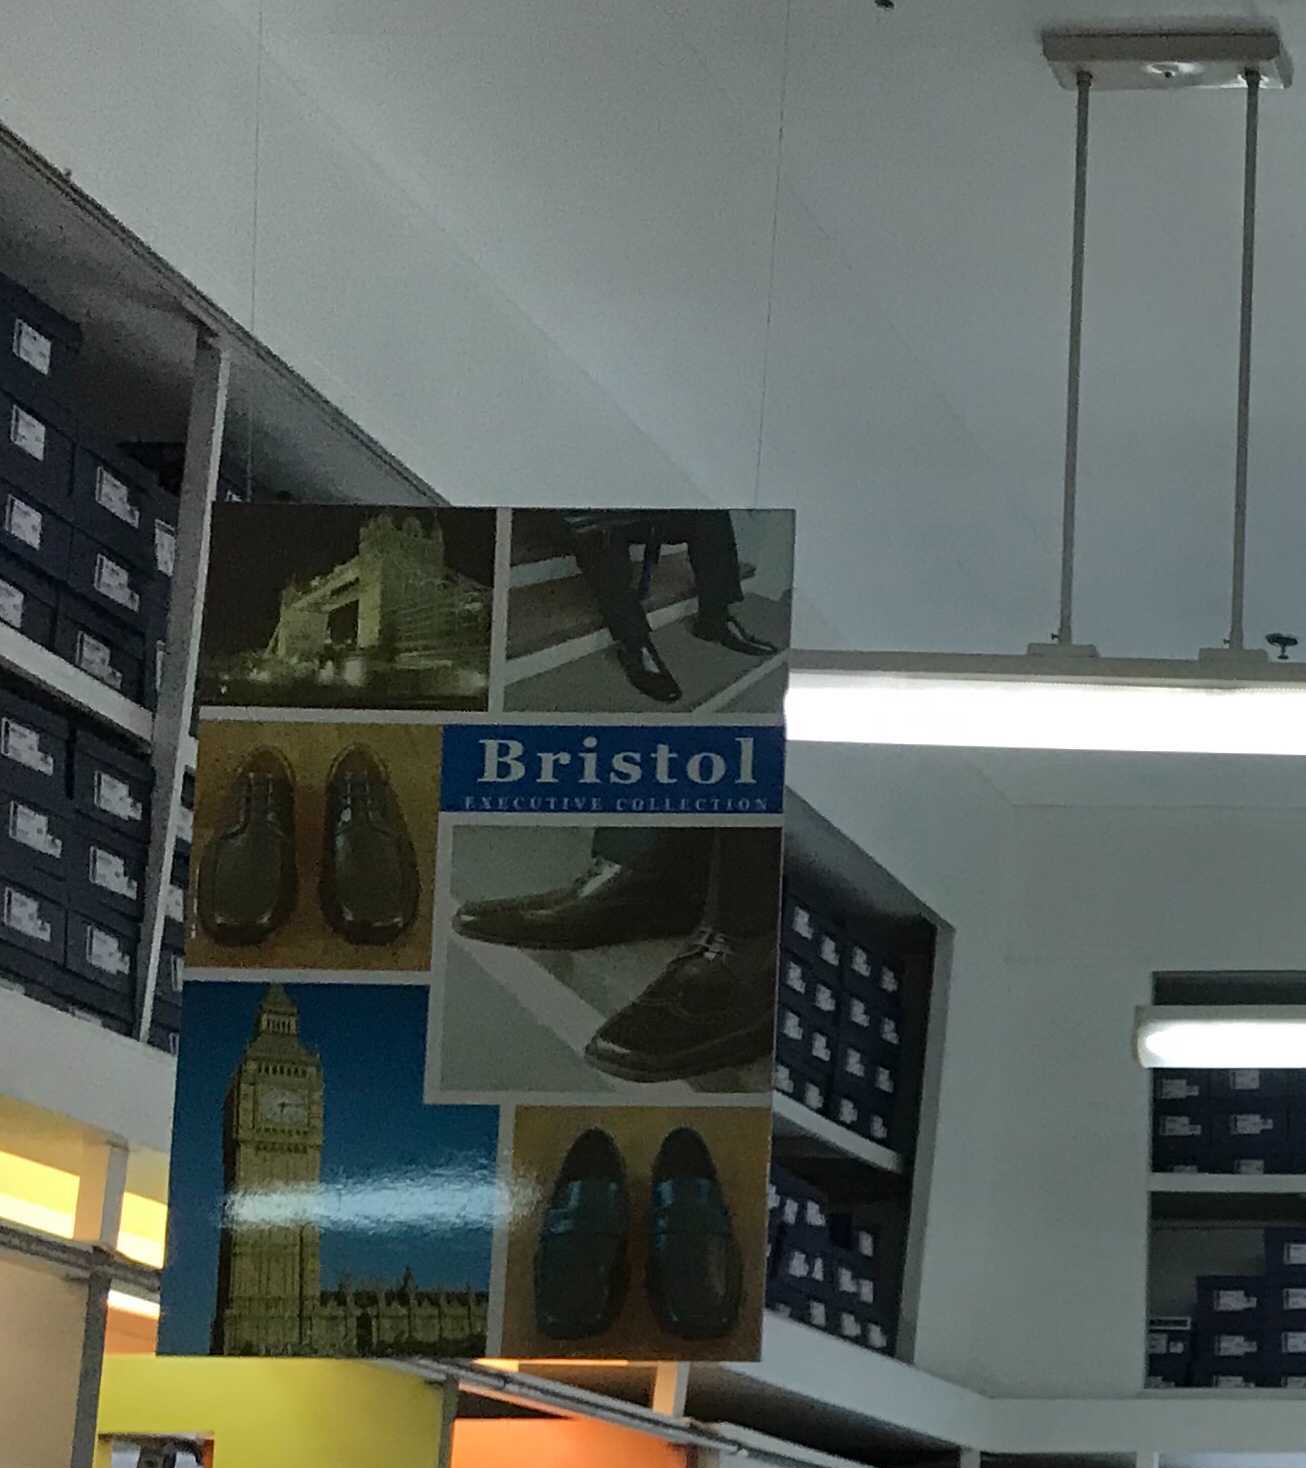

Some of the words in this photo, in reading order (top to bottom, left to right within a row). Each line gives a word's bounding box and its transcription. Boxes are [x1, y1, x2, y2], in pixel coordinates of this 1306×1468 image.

[476, 736, 758, 786] Bristol
[464, 796, 602, 811] EXECUTIVE
[616, 797, 769, 812] COLLECTION
